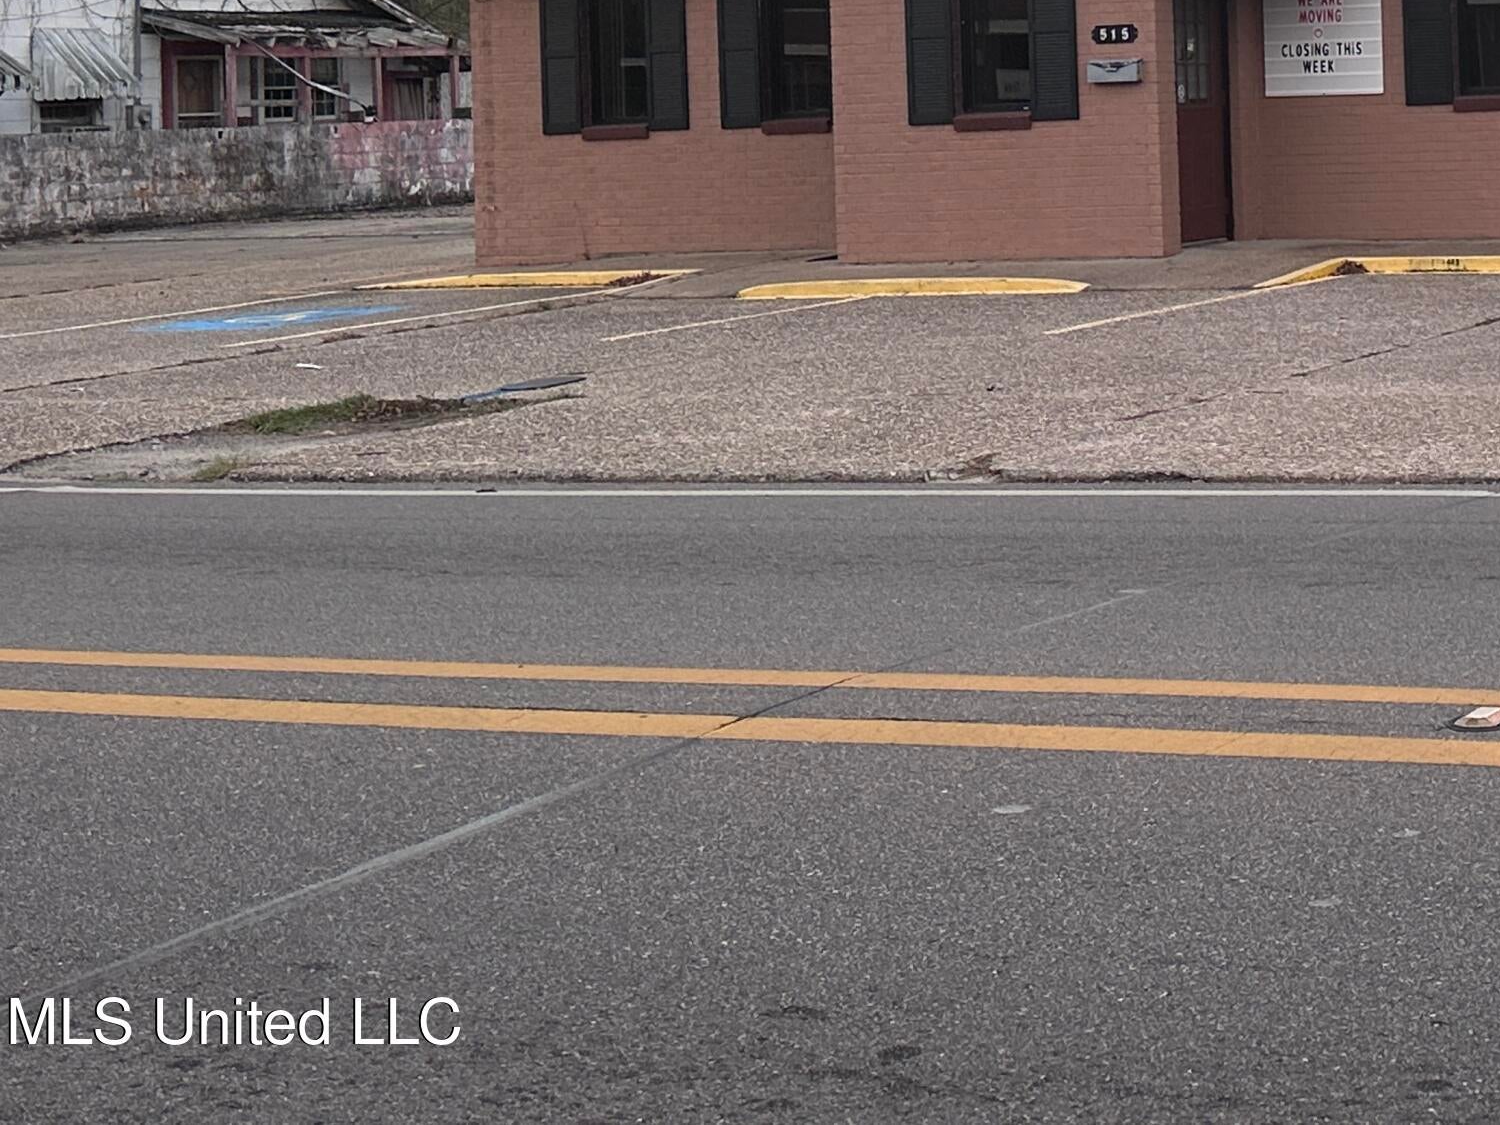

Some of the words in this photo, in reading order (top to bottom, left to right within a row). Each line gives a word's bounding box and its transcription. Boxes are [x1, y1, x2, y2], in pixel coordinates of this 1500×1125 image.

[1298, 9, 1342, 23] MOVING
[1100, 27, 1129, 41] 515
[1281, 43, 1330, 58] CLOSING
[1302, 60, 1335, 73] WEEK
